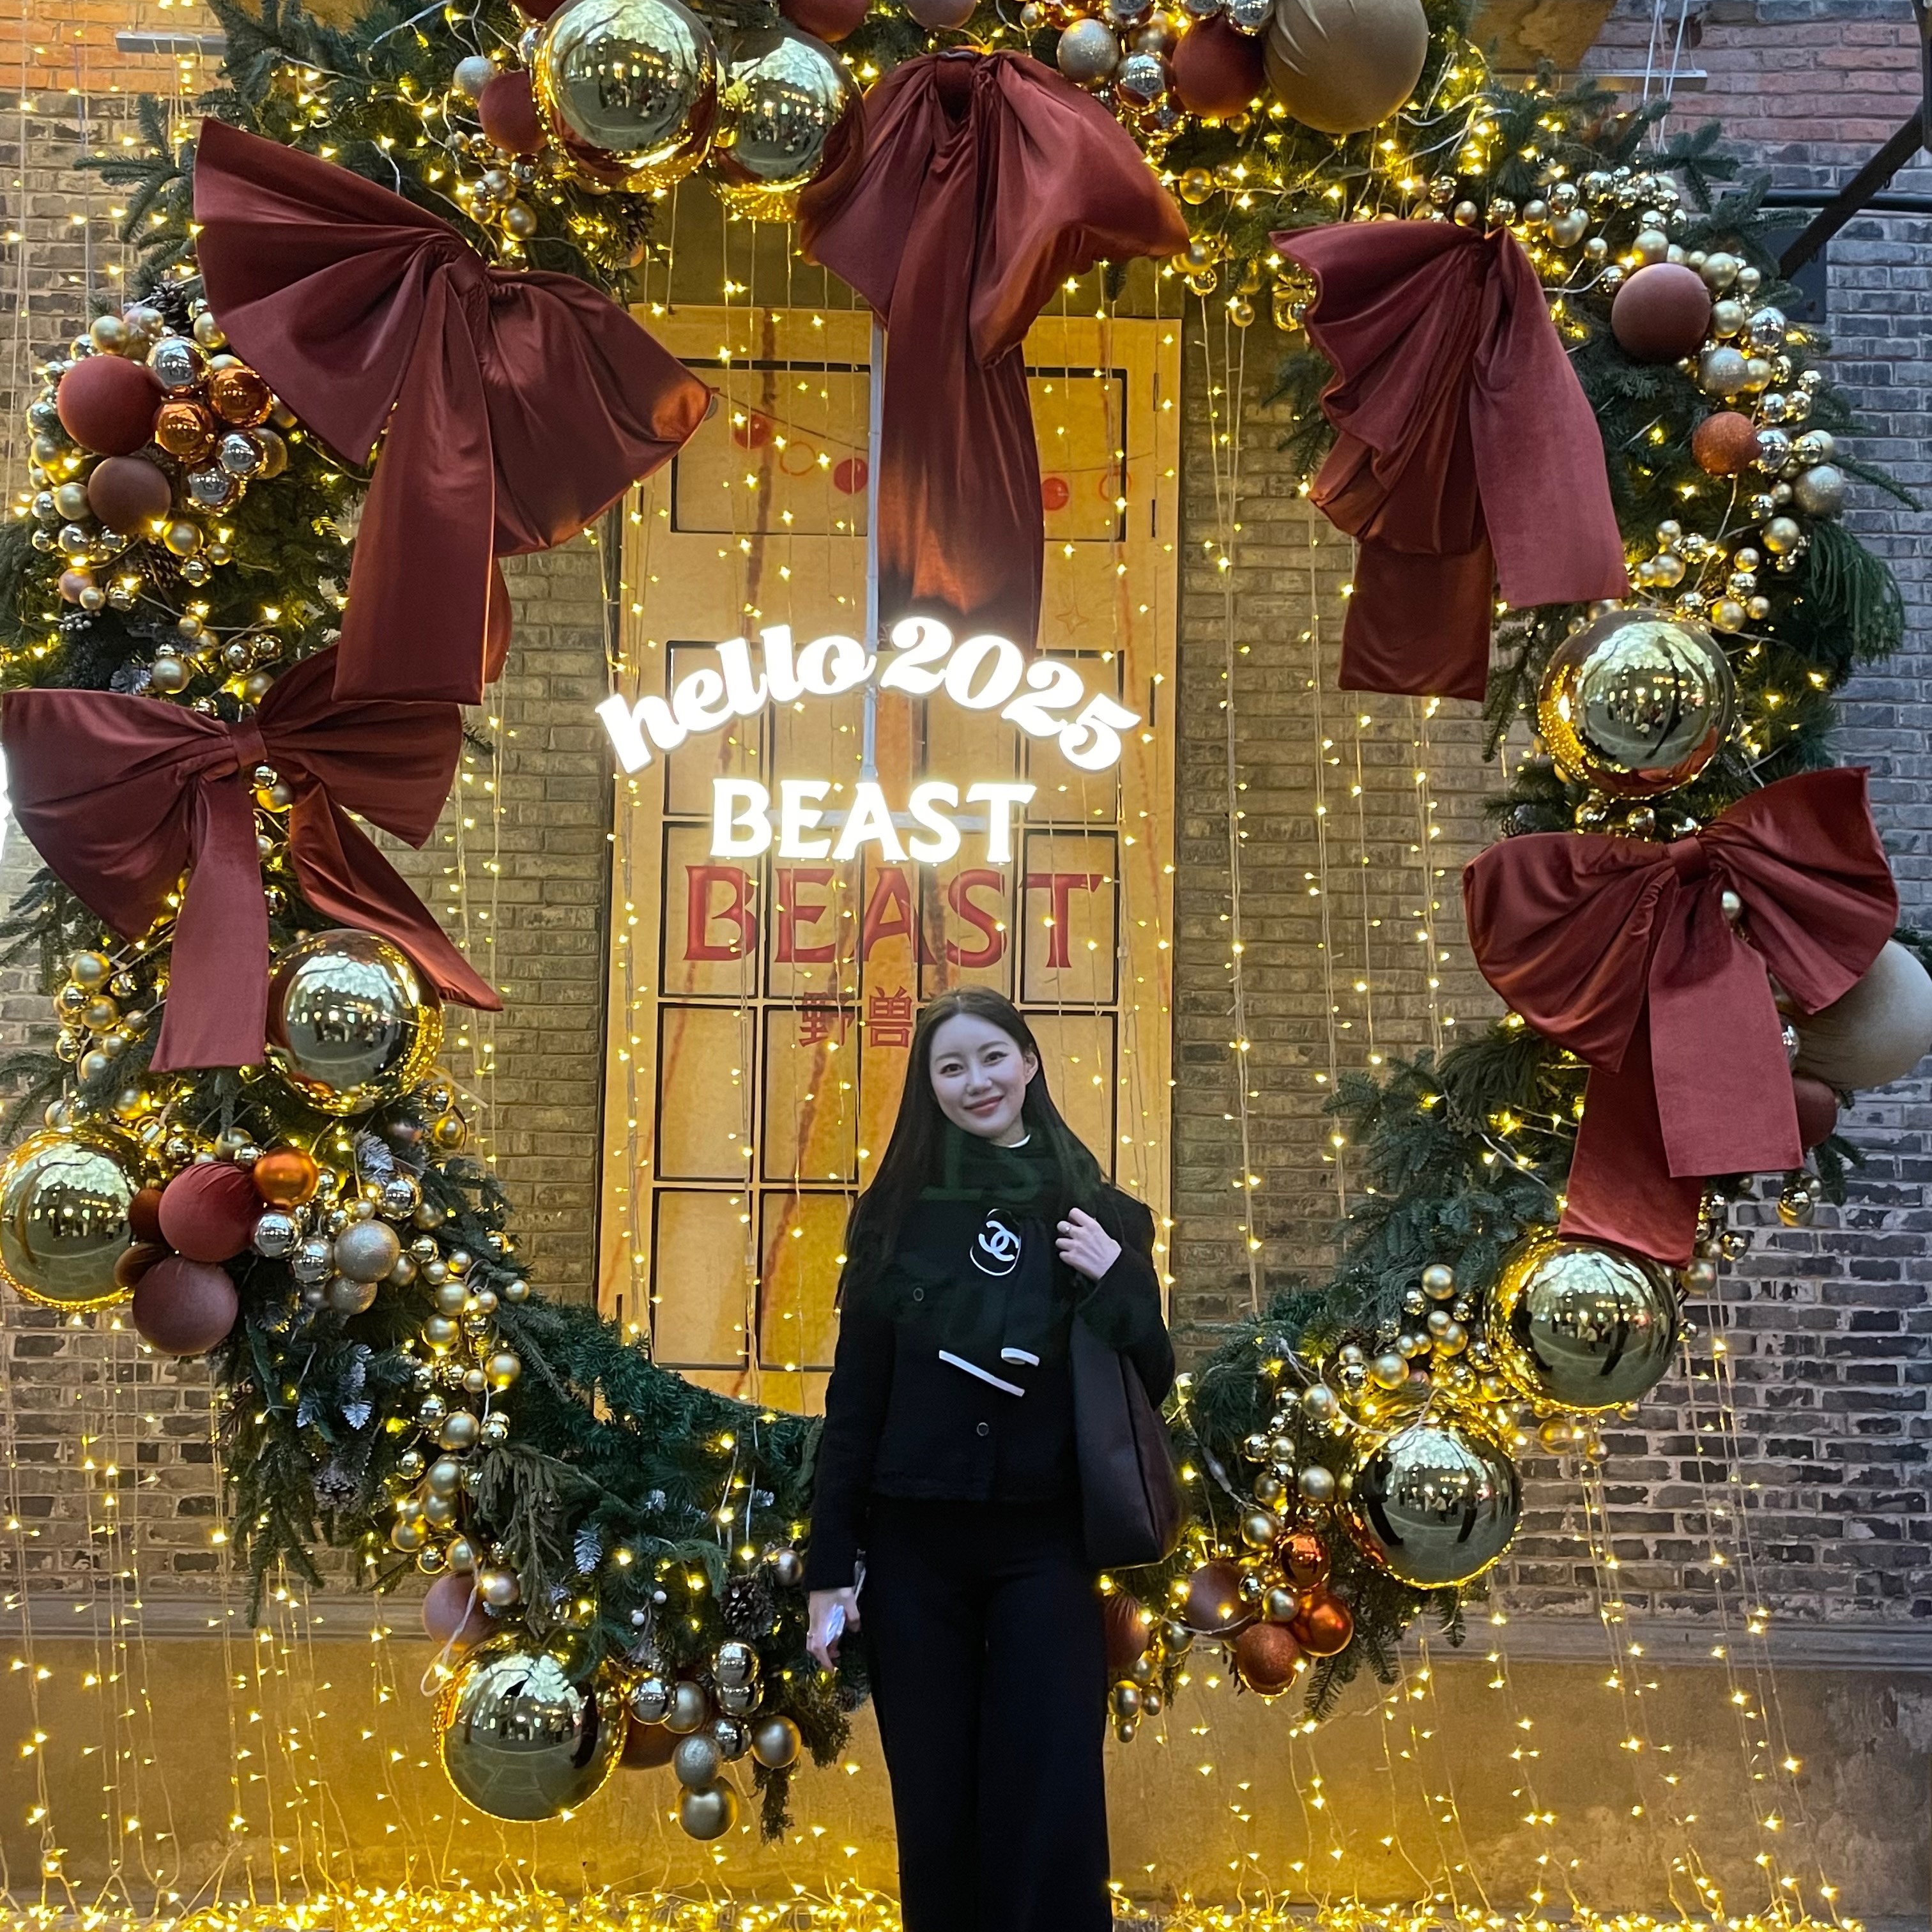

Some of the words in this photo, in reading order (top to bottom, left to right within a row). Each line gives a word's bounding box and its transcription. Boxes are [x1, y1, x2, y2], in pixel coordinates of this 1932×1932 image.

[594, 624, 877, 774] hello
[879, 615, 1142, 771] 2025
[709, 778, 1038, 864] BEAST
[683, 864, 1102, 969] BEAST
